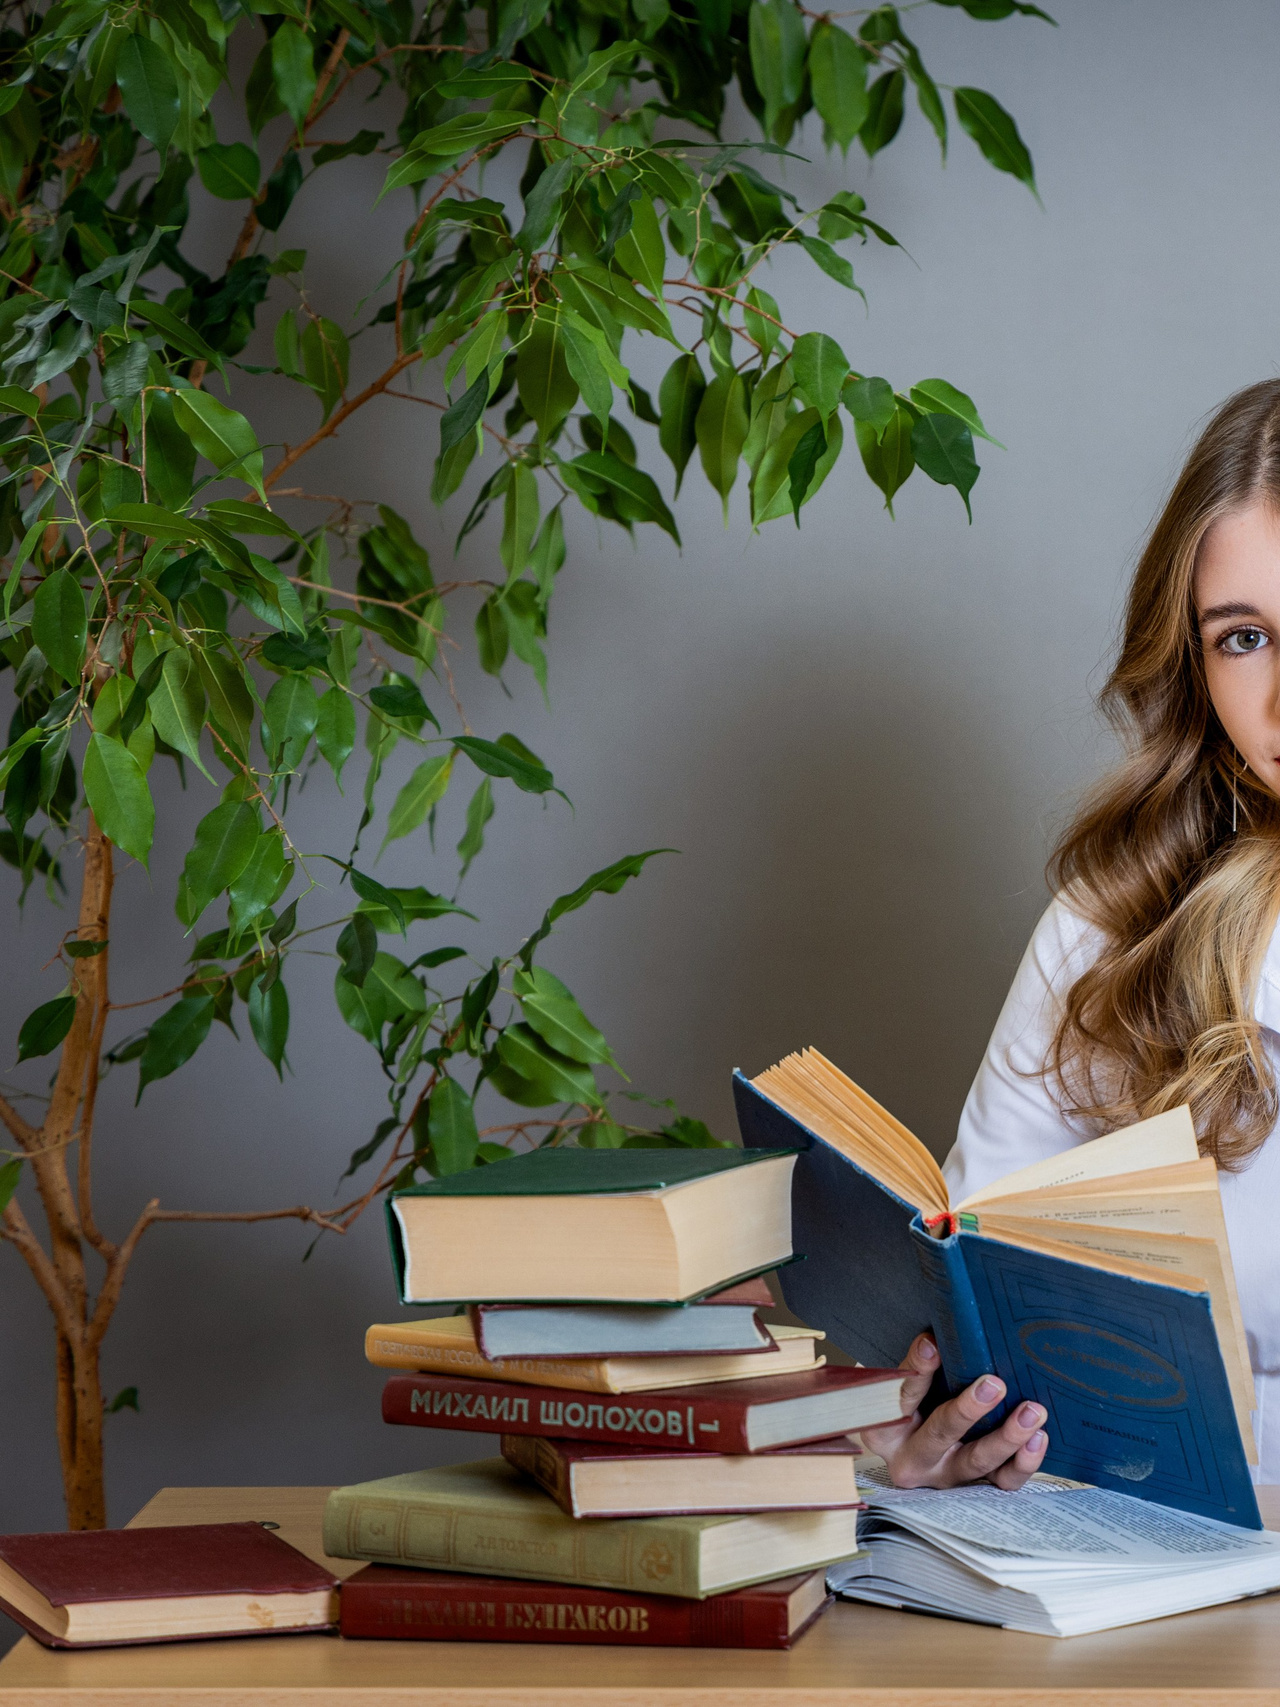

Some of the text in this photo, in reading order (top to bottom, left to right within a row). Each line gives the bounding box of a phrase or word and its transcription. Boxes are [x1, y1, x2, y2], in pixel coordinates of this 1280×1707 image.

[410, 1388, 529, 1422] МИХАИЛ
[540, 1400, 683, 1436] ШОЛОХОВ
[504, 1602, 650, 1632] БУЛГАКОВ
